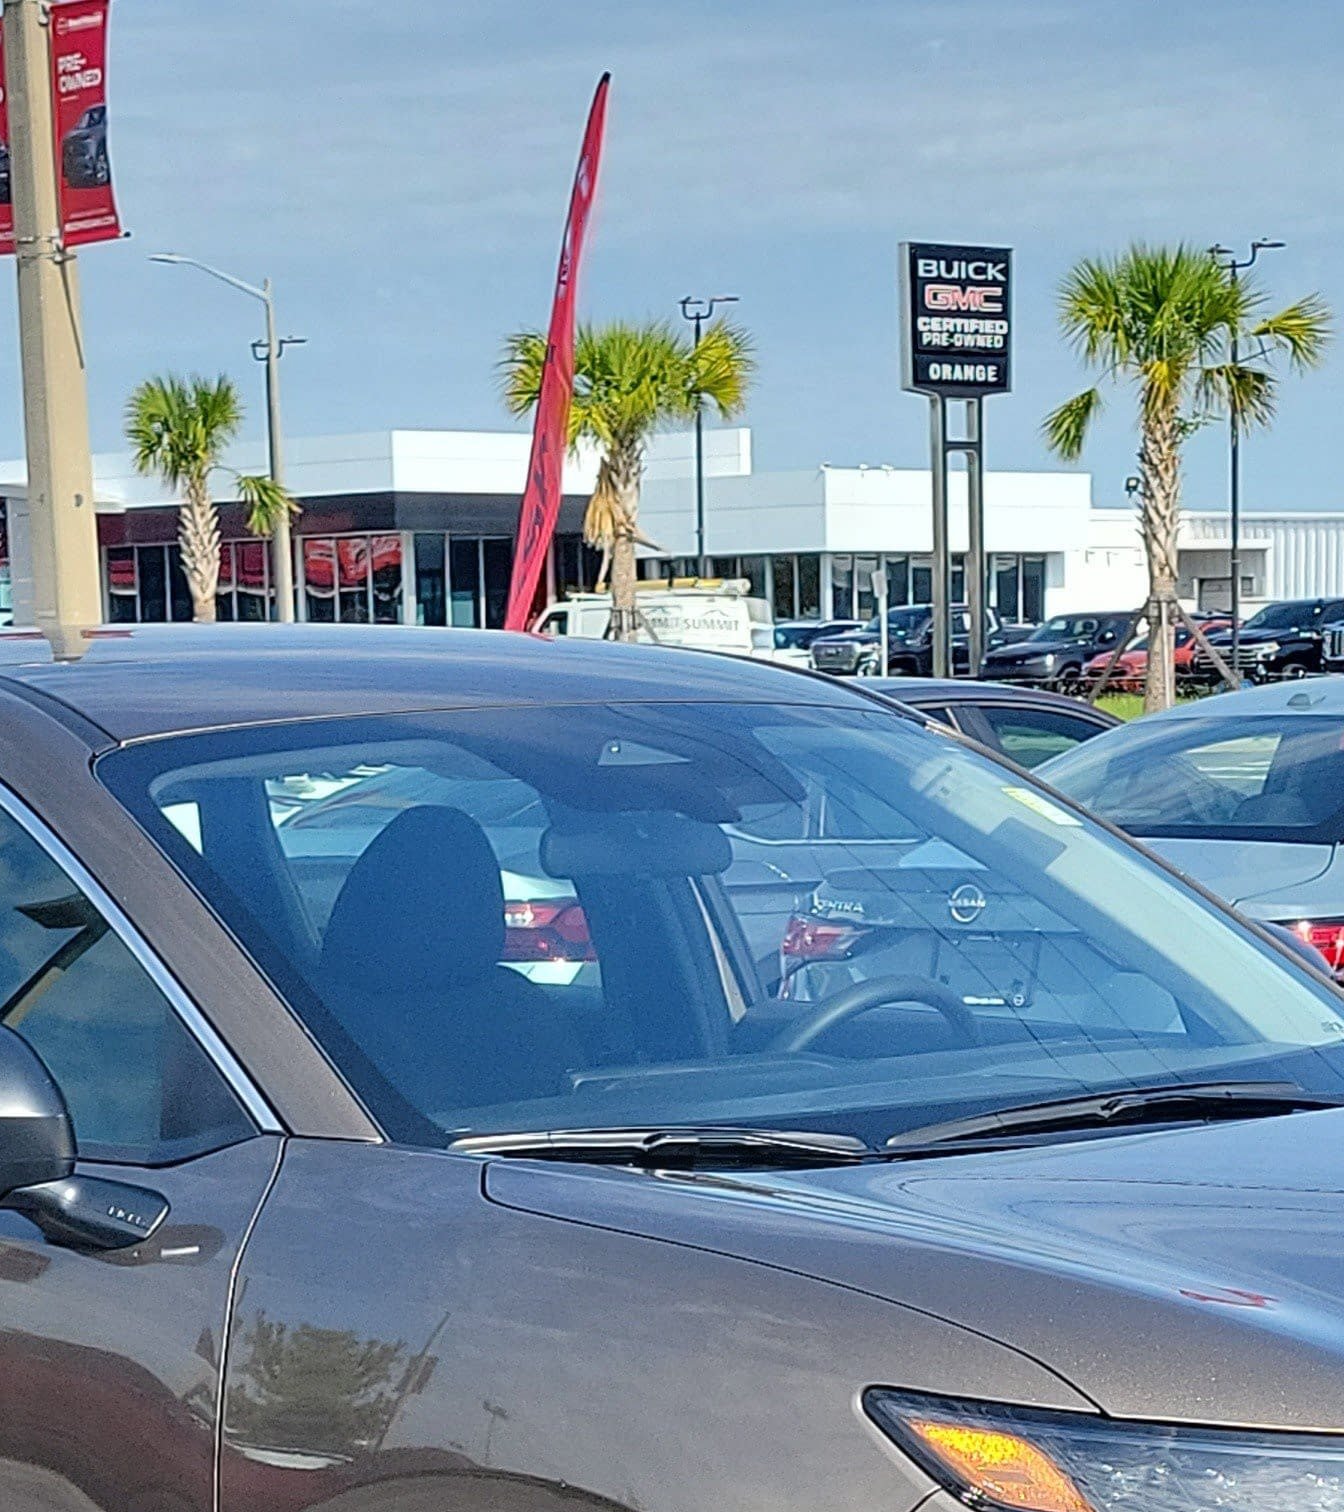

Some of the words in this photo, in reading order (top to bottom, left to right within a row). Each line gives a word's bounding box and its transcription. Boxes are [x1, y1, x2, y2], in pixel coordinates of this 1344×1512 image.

[58, 52, 87, 74] PRE-
[59, 68, 102, 93] OWNED
[917, 259, 1007, 281] BUICK
[924, 284, 1003, 312] GMC
[917, 316, 1008, 335] CERTIFIED
[922, 332, 1004, 348] PRE-OWNED
[928, 362, 998, 382] ORANGE
[684, 618, 739, 631] SUMMIT
